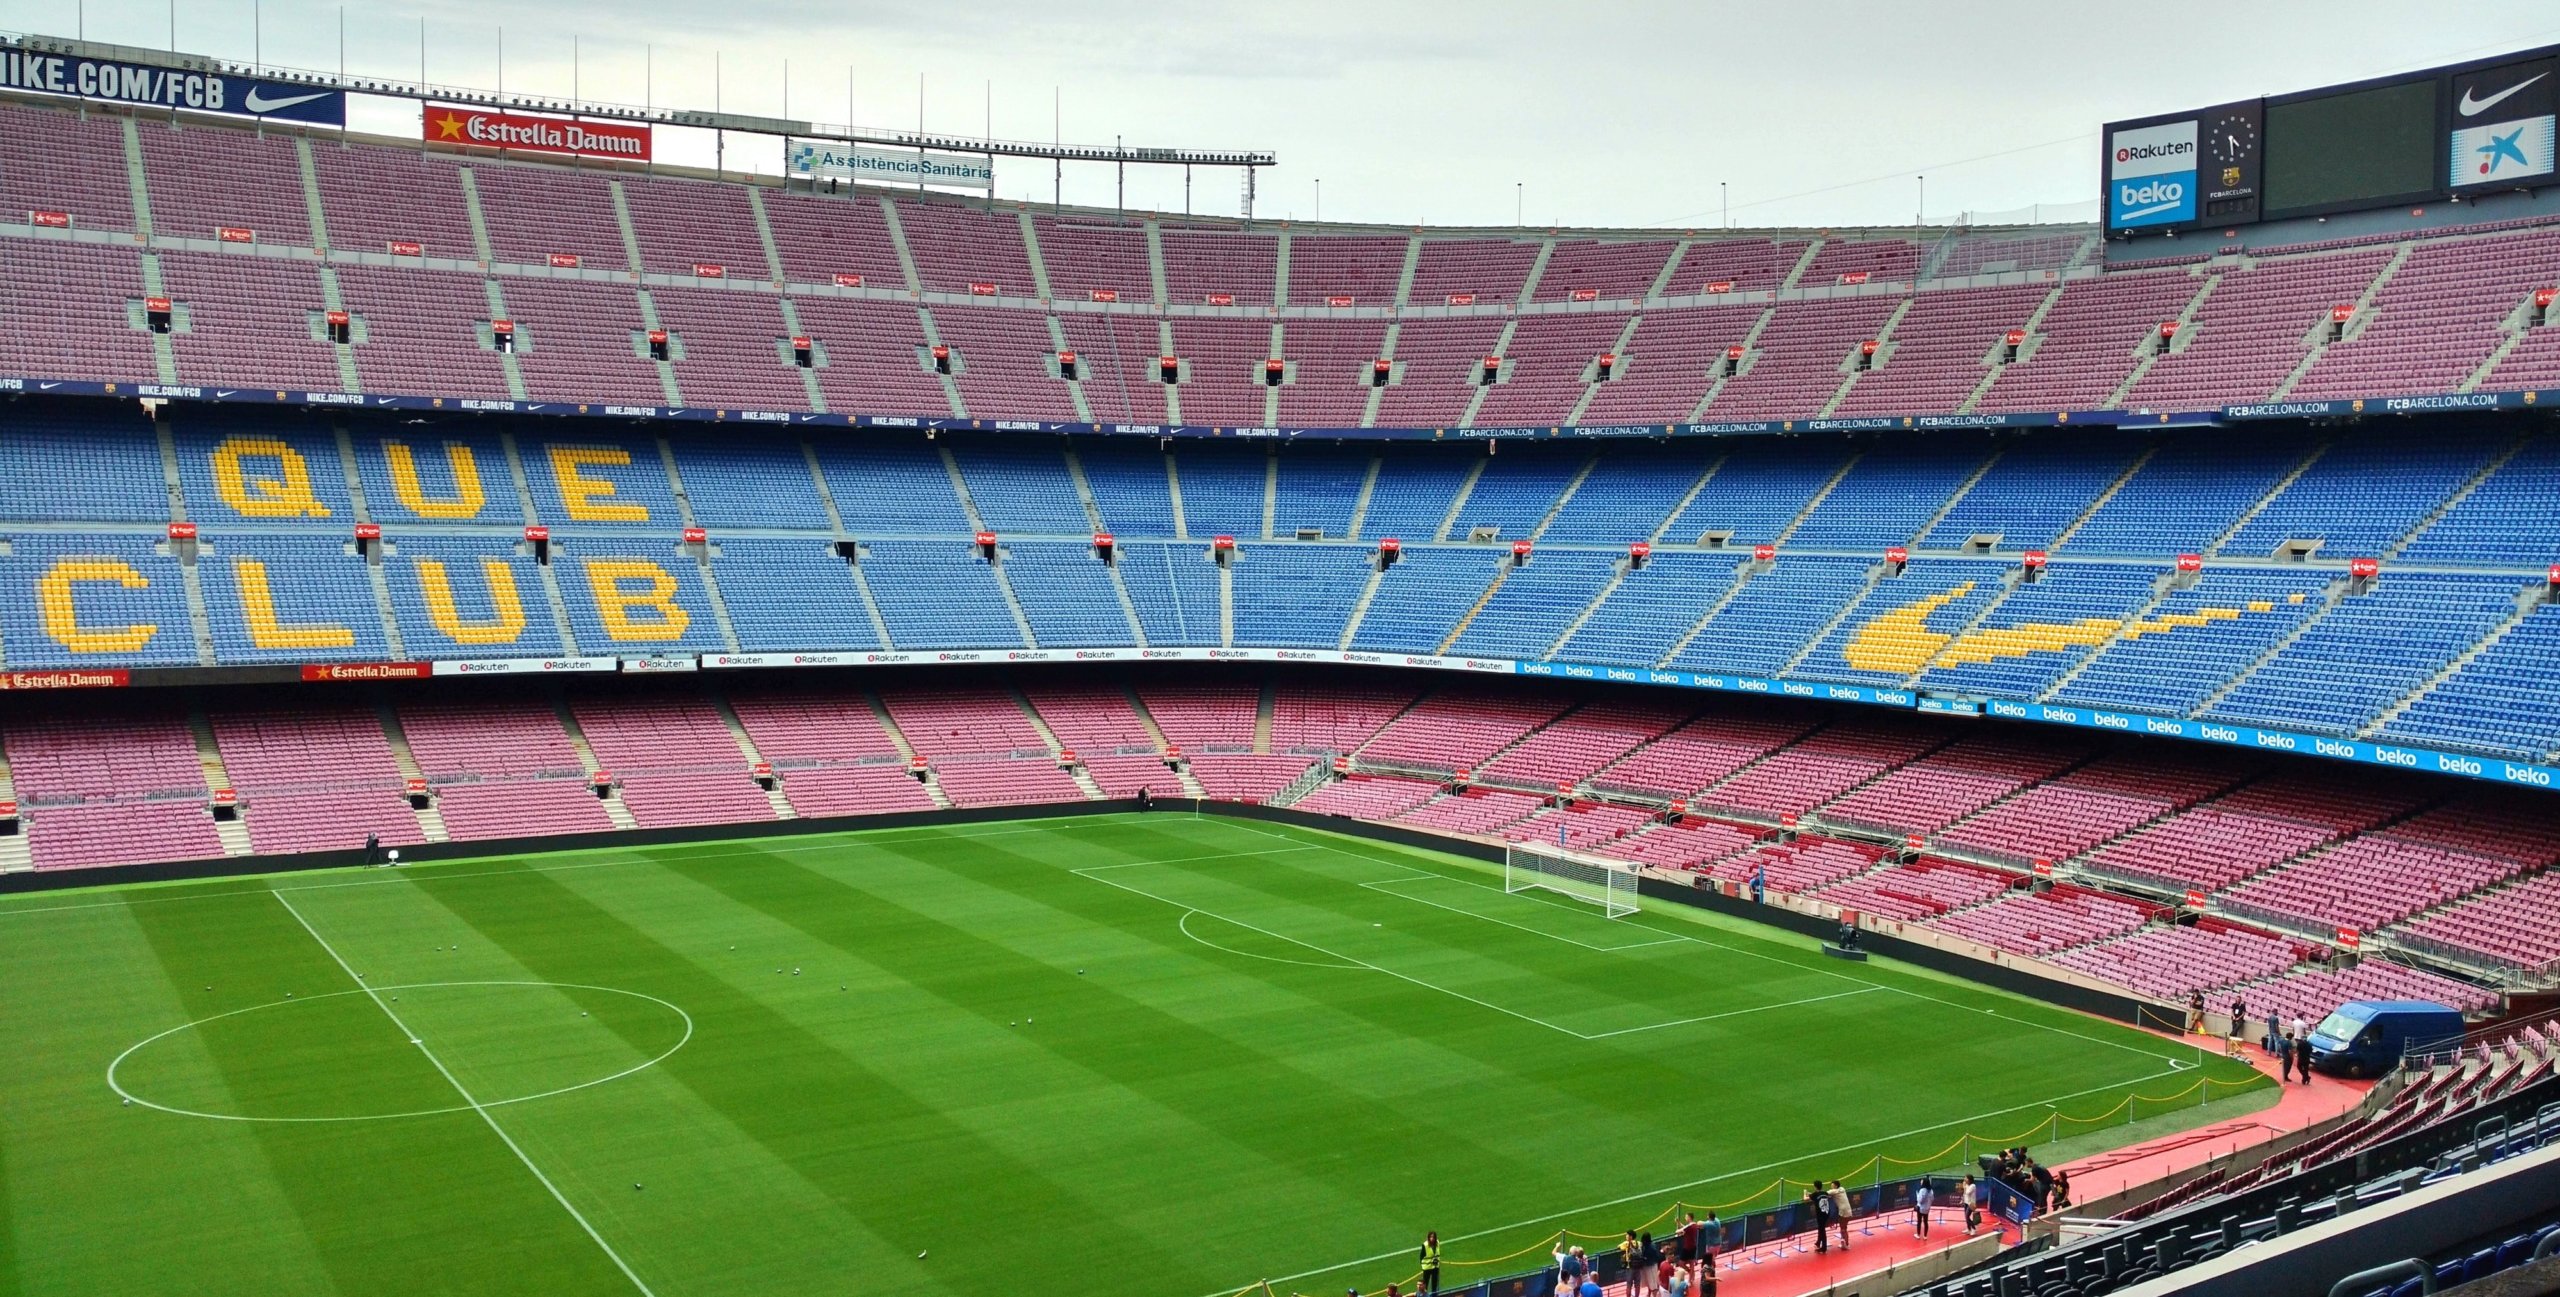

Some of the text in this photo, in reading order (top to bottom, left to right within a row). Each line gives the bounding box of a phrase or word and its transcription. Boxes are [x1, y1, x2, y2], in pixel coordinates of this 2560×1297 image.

[467, 115, 642, 154] Estrella Damm
[2130, 142, 2193, 160] Rakuten
[822, 152, 992, 179] Assistència Sanitària
[2122, 181, 2183, 206] beko
[2210, 187, 2252, 198] FCBARCELONA
[138, 385, 201, 397] NIKE.COM/FCB
[306, 393, 364, 404] NIKE.COM/FCB
[2387, 395, 2498, 411] FCBARCELONA.COM
[460, 400, 515, 410] NIKE.COM/FCB
[2229, 403, 2329, 417] FCBARCELONA.COM
[605, 406, 656, 416] NIKE.COM/FCB
[741, 411, 790, 421] NIKE.COM/FCB
[871, 417, 918, 426] NIKE.COM/FCB
[995, 421, 1040, 430] NIKE.COM/FCB
[1810, 419, 1890, 429] FCBARCELONA.COM
[1920, 415, 2006, 427] FCBARCELONA.COM
[1115, 425, 1160, 434] NIKE.COM/FCB
[1235, 428, 1280, 436] NIKE.COM/FCB
[1575, 427, 1649, 435] FCBARCELONA.COM
[1690, 423, 1766, 432] FCBARCELONA.COM
[208, 436, 650, 521] QUE
[40, 559, 690, 653] CLUB
[801, 655, 838, 663] Rakuten
[875, 654, 910, 662] Rakuten
[946, 653, 980, 661] Rakuten
[1015, 652, 1048, 660] Rakuten
[1149, 650, 1181, 658] Rakuten
[1283, 651, 1316, 659] Rakuten
[1350, 654, 1381, 663] Rakuten
[551, 661, 591, 669] Rakuten
[645, 660, 684, 668] Rakuten
[725, 657, 763, 665] Rakuten
[1412, 657, 1442, 666] Rakuten
[1473, 660, 1503, 671] Rakuten
[331, 665, 418, 678] Estrella Damm
[468, 663, 509, 672] Rakuten
[1524, 663, 1551, 674] beko
[1566, 665, 1593, 677] beko
[13, 673, 114, 687] Estrella Damm
[1608, 669, 1635, 680] beko
[1651, 672, 1678, 683] beko
[1694, 675, 1723, 687] beko
[1739, 679, 1767, 691] beko
[1784, 682, 1813, 695] beko
[1830, 687, 1859, 699] beko
[1876, 691, 1906, 704] beko
[1921, 700, 1941, 709] beko
[1951, 702, 1973, 711] beko
[1995, 702, 2026, 716] beko
[2044, 707, 2076, 722] beko
[2095, 713, 2128, 728] beko
[2148, 719, 2182, 734] beko
[2202, 725, 2237, 741] beko
[2258, 732, 2295, 749] beko
[2316, 737, 2355, 757] beko
[2376, 747, 2416, 766] beko
[2440, 755, 2481, 774] beko
[2506, 762, 2549, 785] beko
